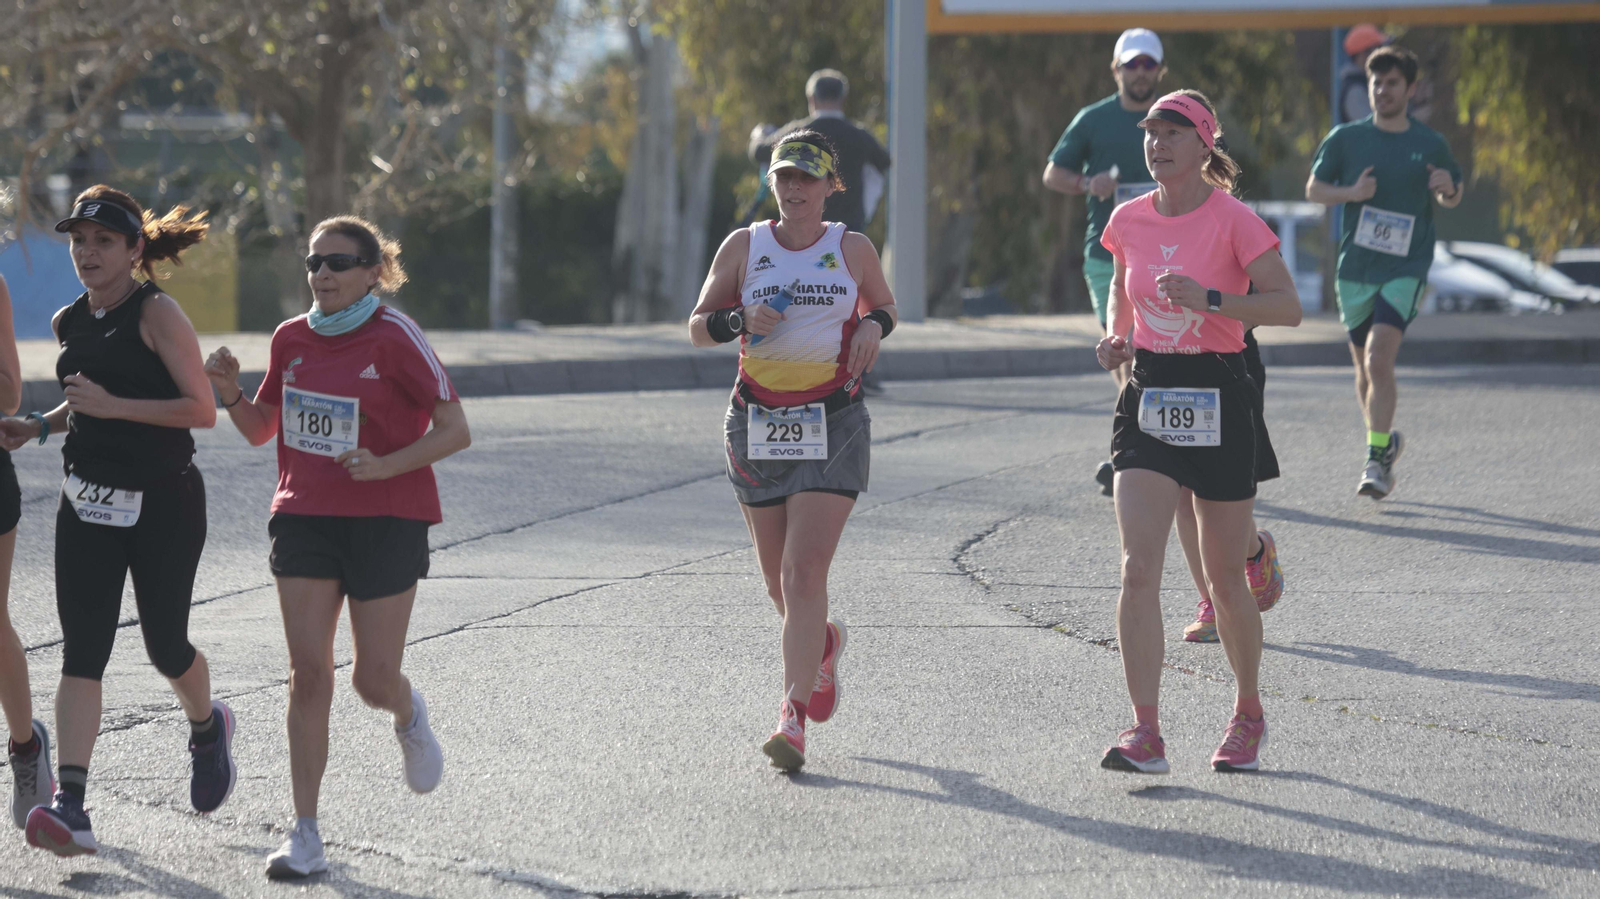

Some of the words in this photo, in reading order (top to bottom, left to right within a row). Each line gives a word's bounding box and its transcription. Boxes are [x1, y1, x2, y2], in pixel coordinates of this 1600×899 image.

[1374, 222, 1392, 241] 66
[752, 285, 780, 300] CLUB
[784, 283, 847, 296] RIATLÓN
[1152, 344, 1202, 355] MARTÓN
[359, 372, 380, 380] adidas
[301, 397, 333, 411] MARATÓN
[1162, 394, 1195, 403] MARATÓN
[297, 410, 333, 438] 180
[1157, 406, 1195, 429] 189
[766, 421, 803, 443] 229
[1159, 434, 1196, 442] EVOS
[298, 439, 333, 452] EVOS
[768, 448, 804, 456] EVOS
[76, 480, 116, 507] 232
[76, 508, 112, 521] EVOS
